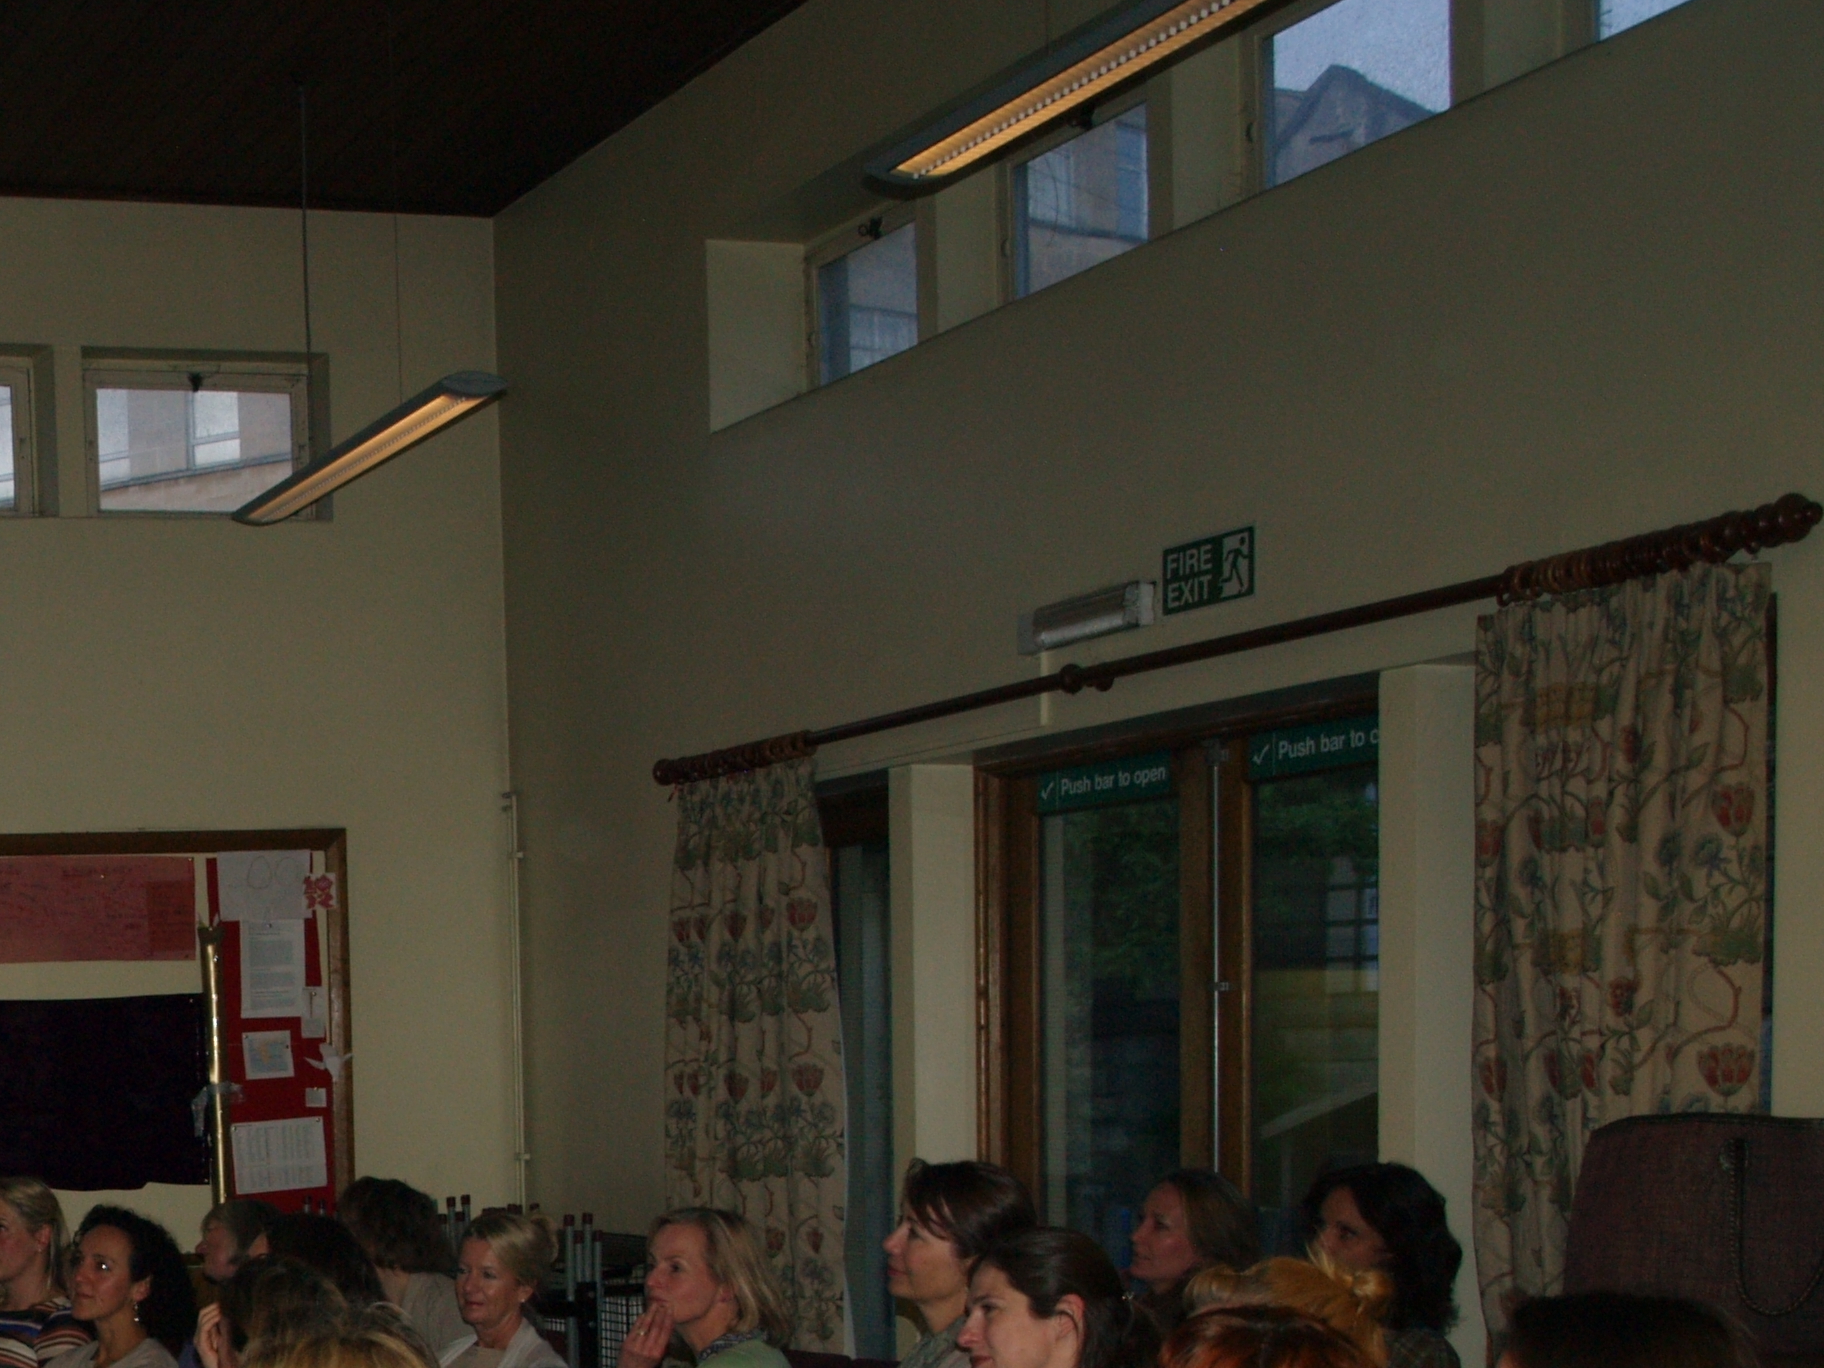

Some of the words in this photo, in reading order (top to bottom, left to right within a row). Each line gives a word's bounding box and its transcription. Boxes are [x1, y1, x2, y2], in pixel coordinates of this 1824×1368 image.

[1166, 543, 1213, 579] FIRE
[1166, 574, 1213, 609] EXIT
[1277, 735, 1316, 761] Push
[1320, 731, 1346, 753] bar
[1350, 727, 1366, 749] to
[1060, 774, 1092, 797] Push
[1094, 772, 1116, 791] bar
[1118, 769, 1131, 788] to
[1133, 765, 1167, 789] open
